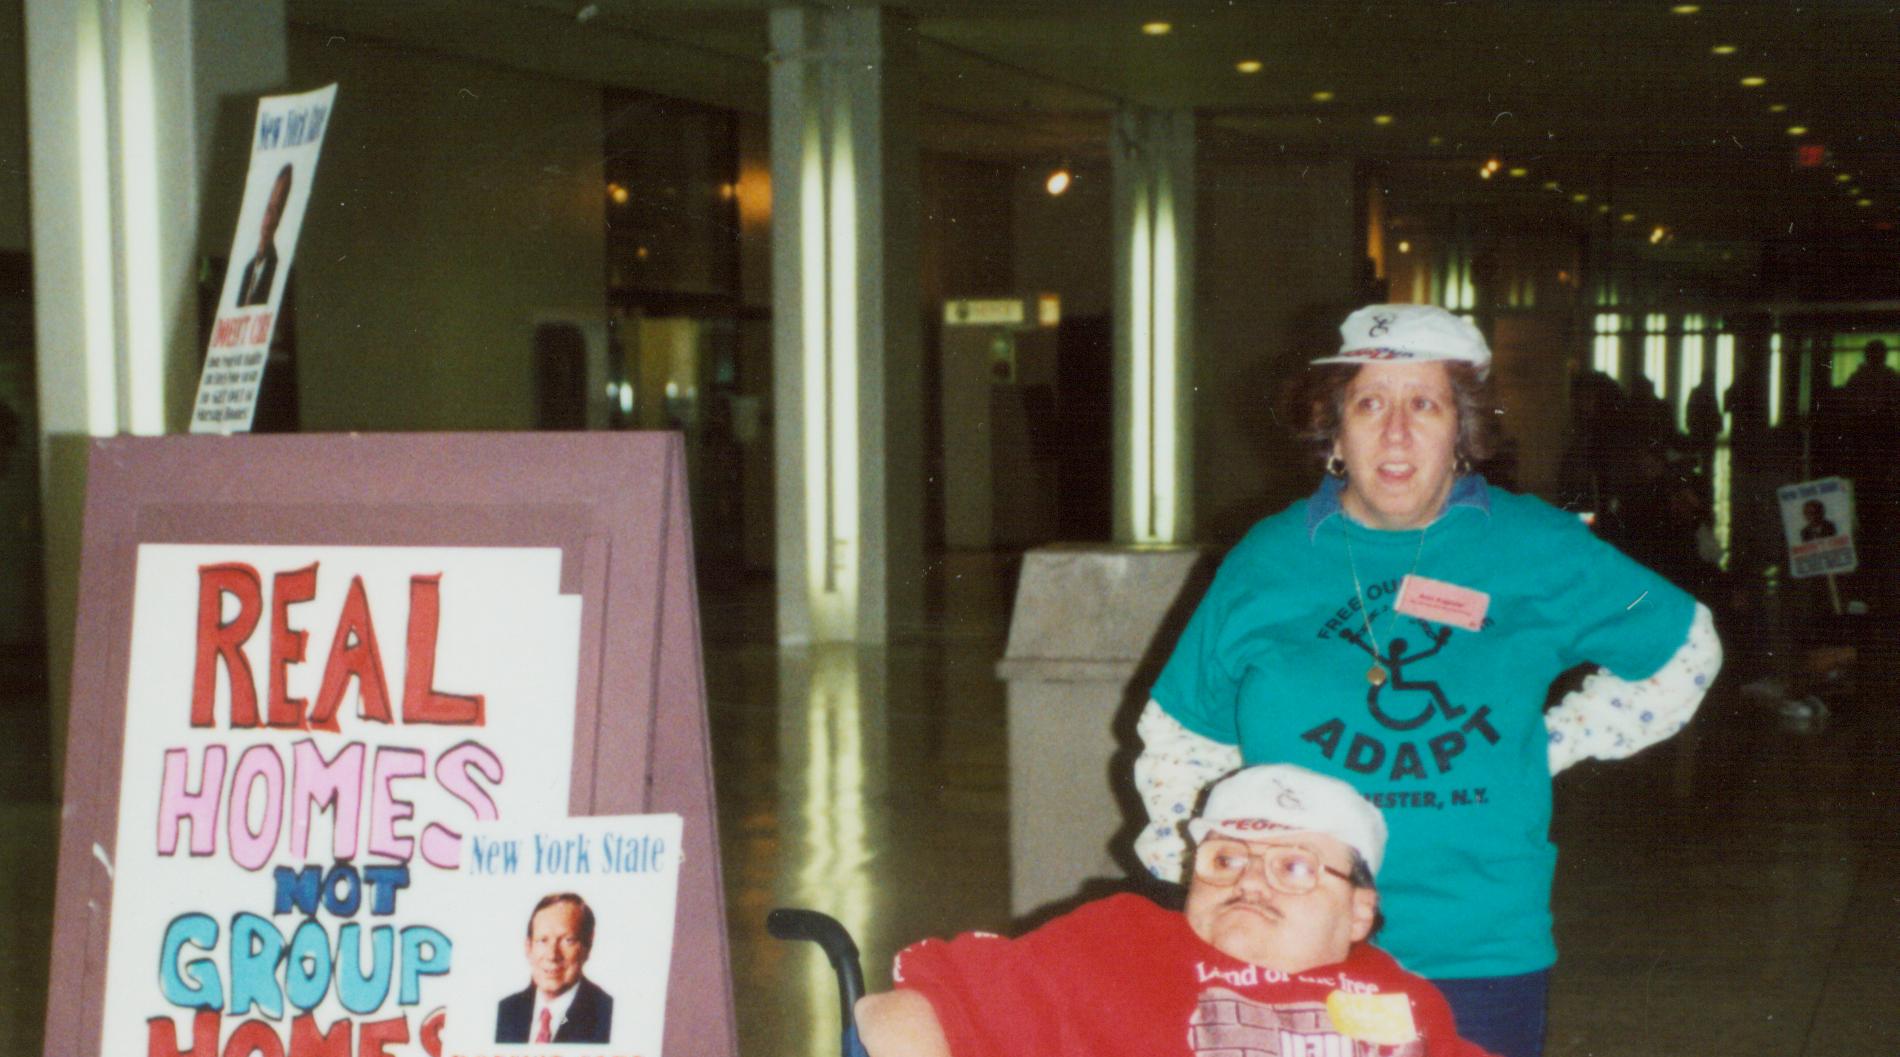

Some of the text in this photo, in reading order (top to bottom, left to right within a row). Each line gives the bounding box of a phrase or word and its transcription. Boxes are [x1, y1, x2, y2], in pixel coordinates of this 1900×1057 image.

[1317, 597, 1362, 641] FREE
[1366, 577, 1404, 601] OU
[190, 561, 485, 733] REAL
[1300, 704, 1501, 781] ADAPT
[156, 738, 504, 872] HOMES
[469, 829, 666, 876] New York State
[273, 863, 410, 917] NOT
[160, 911, 453, 1021] GROUP
[1338, 972, 1379, 994] free
